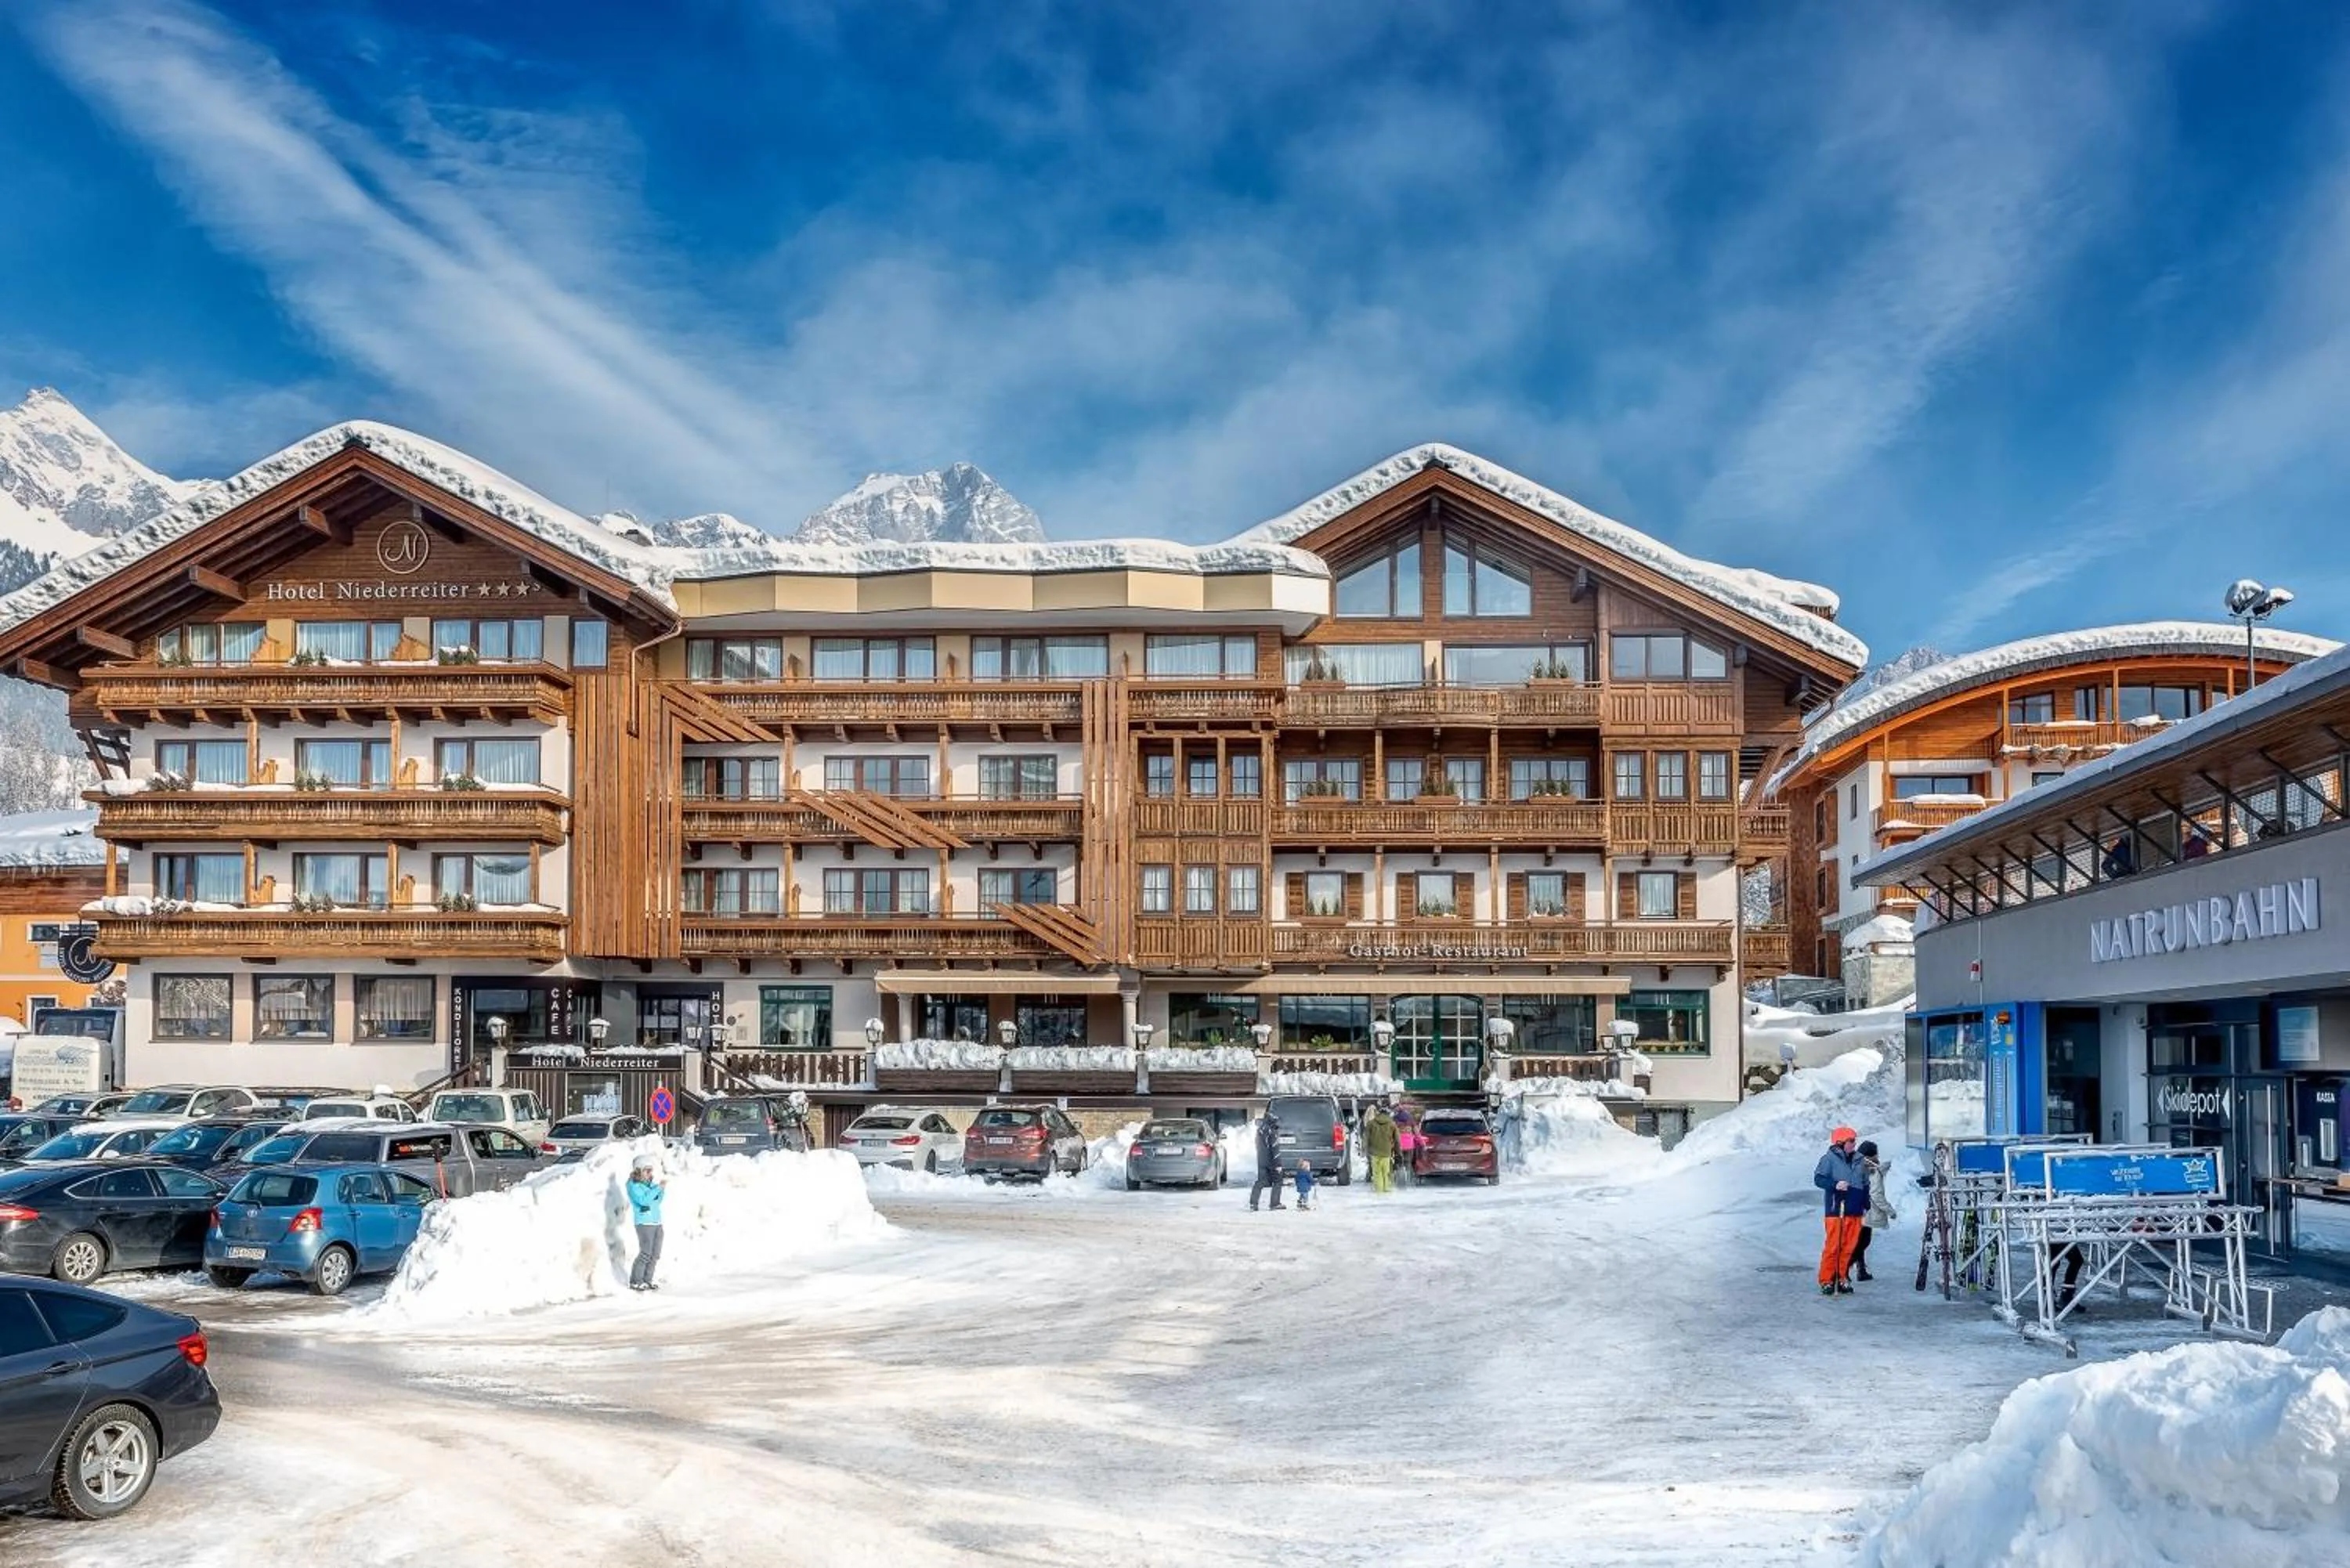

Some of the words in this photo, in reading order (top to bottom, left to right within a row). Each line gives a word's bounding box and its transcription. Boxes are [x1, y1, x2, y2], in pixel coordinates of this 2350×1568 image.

[268, 582, 324, 599] Hotel
[338, 581, 469, 599] Niederreiter
[2091, 877, 2319, 963] NATRUNBAHN
[580, 1056, 660, 1068] Niederreiter
[2164, 1085, 2221, 1120] Skidepot
